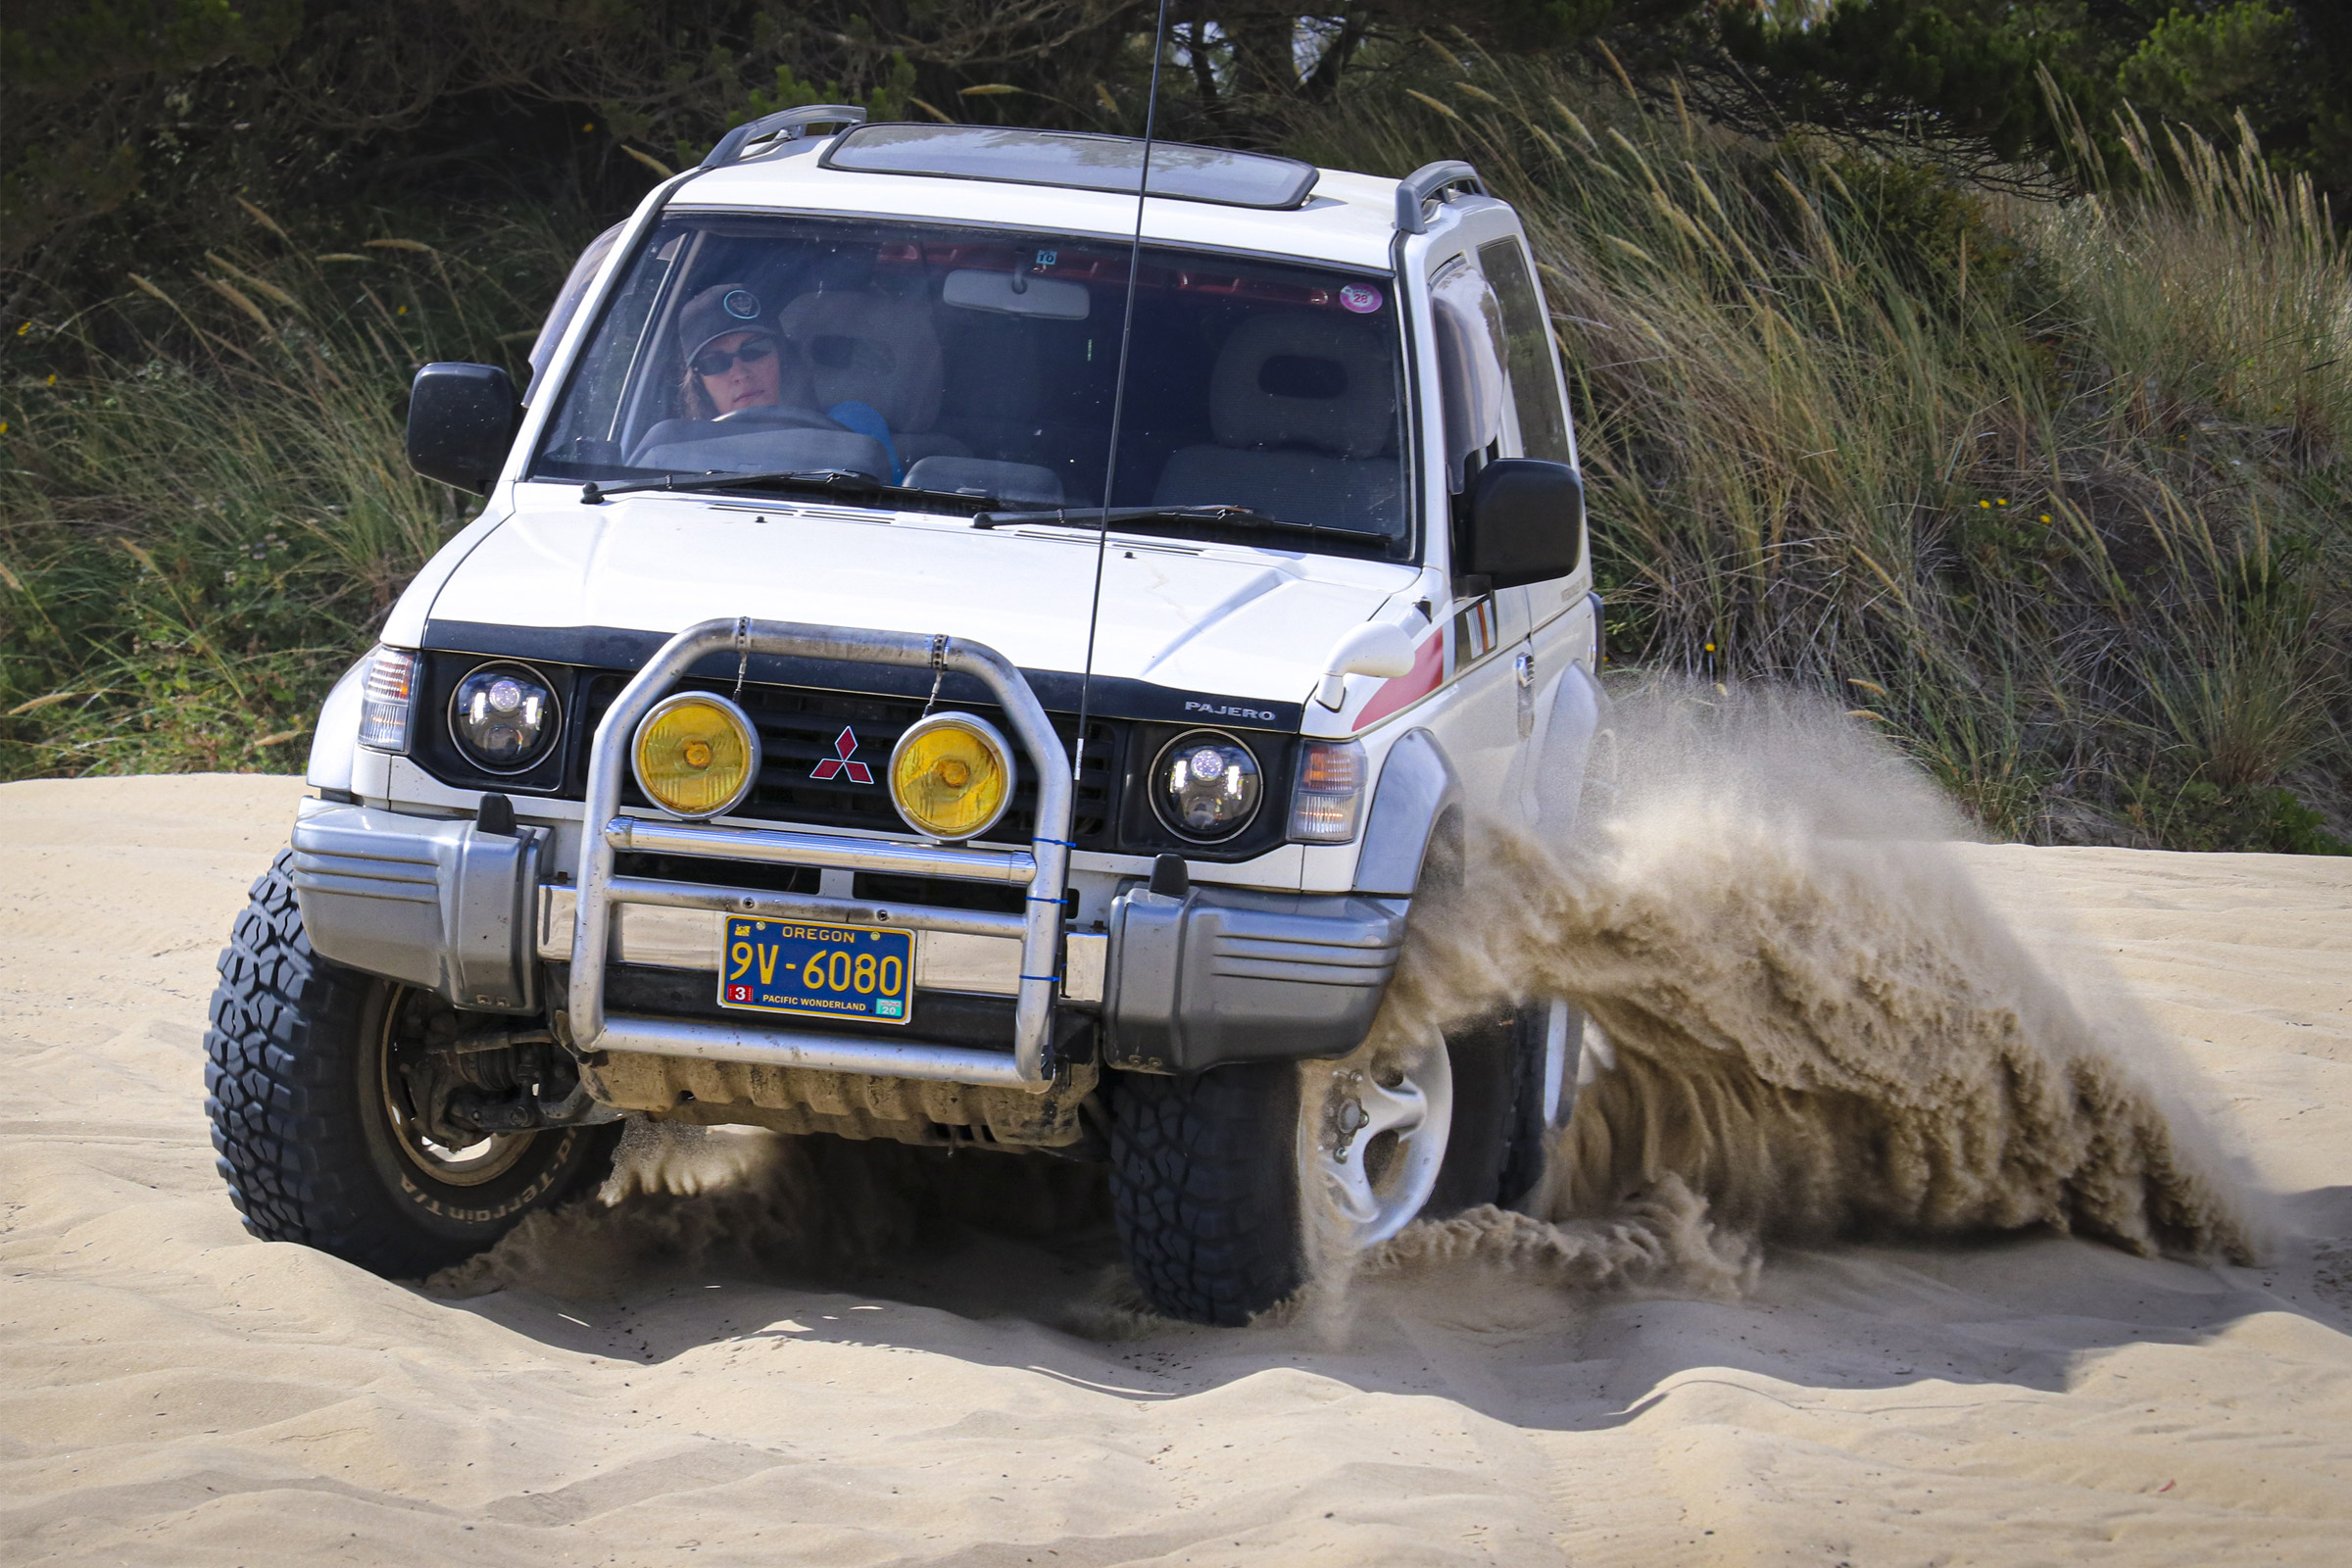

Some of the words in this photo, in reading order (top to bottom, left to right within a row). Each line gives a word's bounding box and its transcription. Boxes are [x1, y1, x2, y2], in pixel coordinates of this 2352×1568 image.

[1039, 254, 1054, 263] 10
[1353, 294, 1368, 304] 28
[1184, 701, 1276, 721] PAJERO
[782, 926, 856, 944] OREGON
[729, 941, 903, 997] 9V-6080
[734, 986, 746, 1001] 3
[762, 994, 799, 1005] PACIFIC
[801, 998, 866, 1011] WONDERLAND
[882, 1005, 897, 1015] 20
